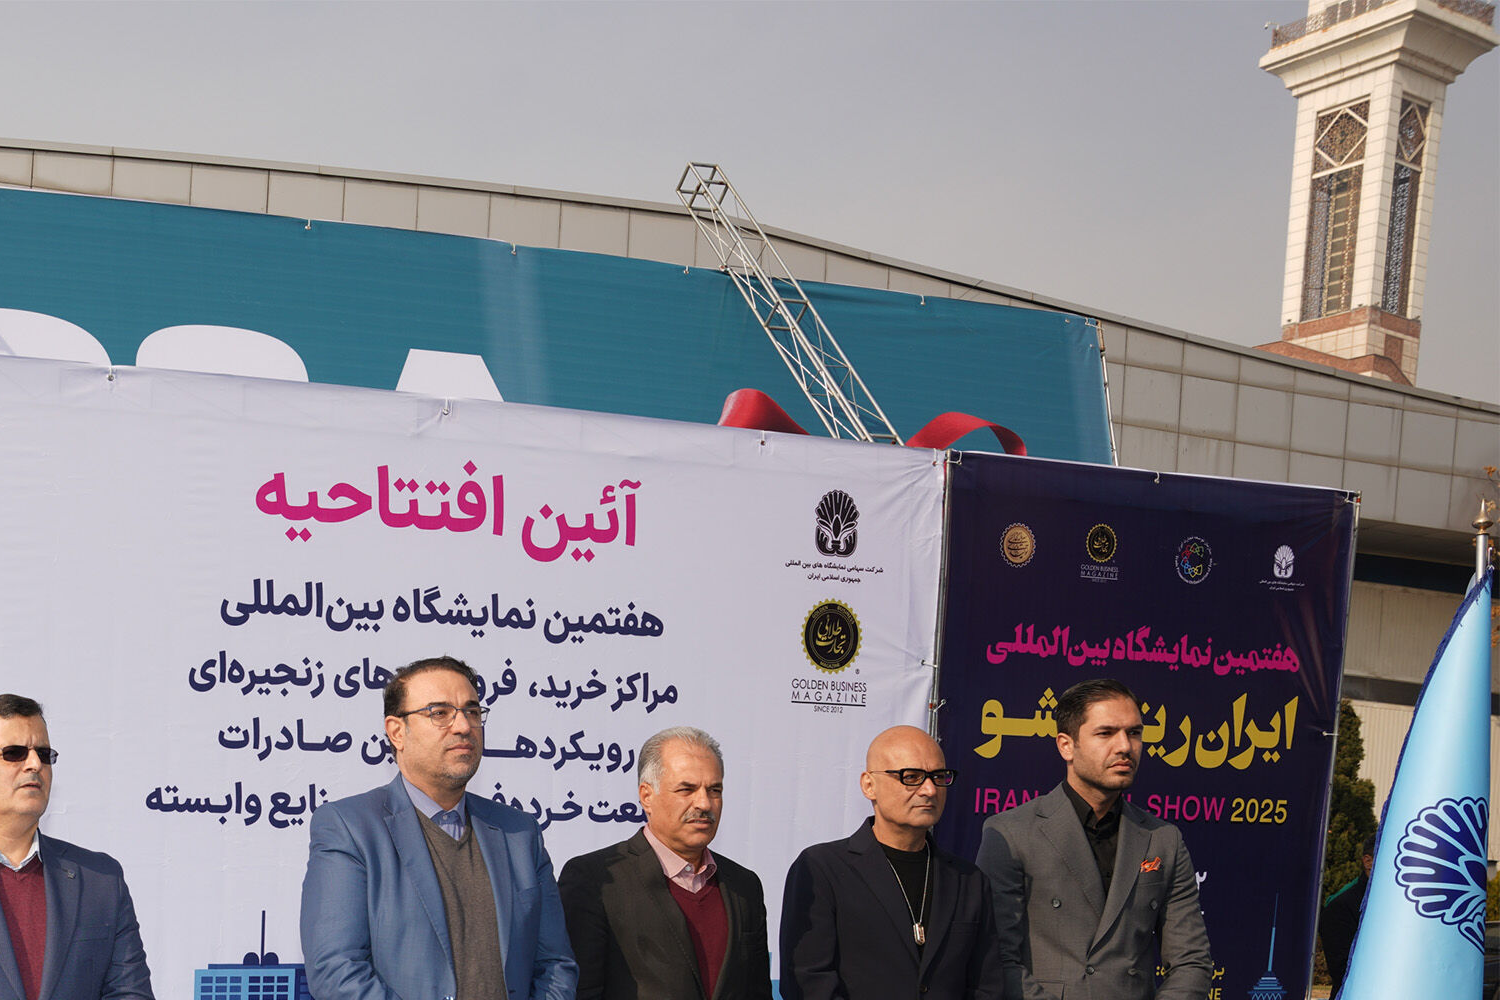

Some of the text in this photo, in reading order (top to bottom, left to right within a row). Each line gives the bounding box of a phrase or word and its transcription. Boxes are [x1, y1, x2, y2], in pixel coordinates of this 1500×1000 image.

[255, 461, 642, 563] آئین افتتاحیه
[392, 585, 537, 638] نمایشگاه
[543, 601, 664, 645] هفتمین
[1112, 625, 1213, 672] نمایشگاه
[1212, 642, 1301, 677] هفتمین
[610, 671, 679, 714] مراکز
[791, 678, 867, 693] GOLDEN BUSINESS
[791, 691, 866, 704] MAGAZINE
[218, 716, 353, 762] صادرات
[1194, 692, 1299, 770] ایران
[145, 781, 262, 827] وابسته
[1147, 794, 1227, 822] SHOW
[1230, 797, 1288, 824] 2025
